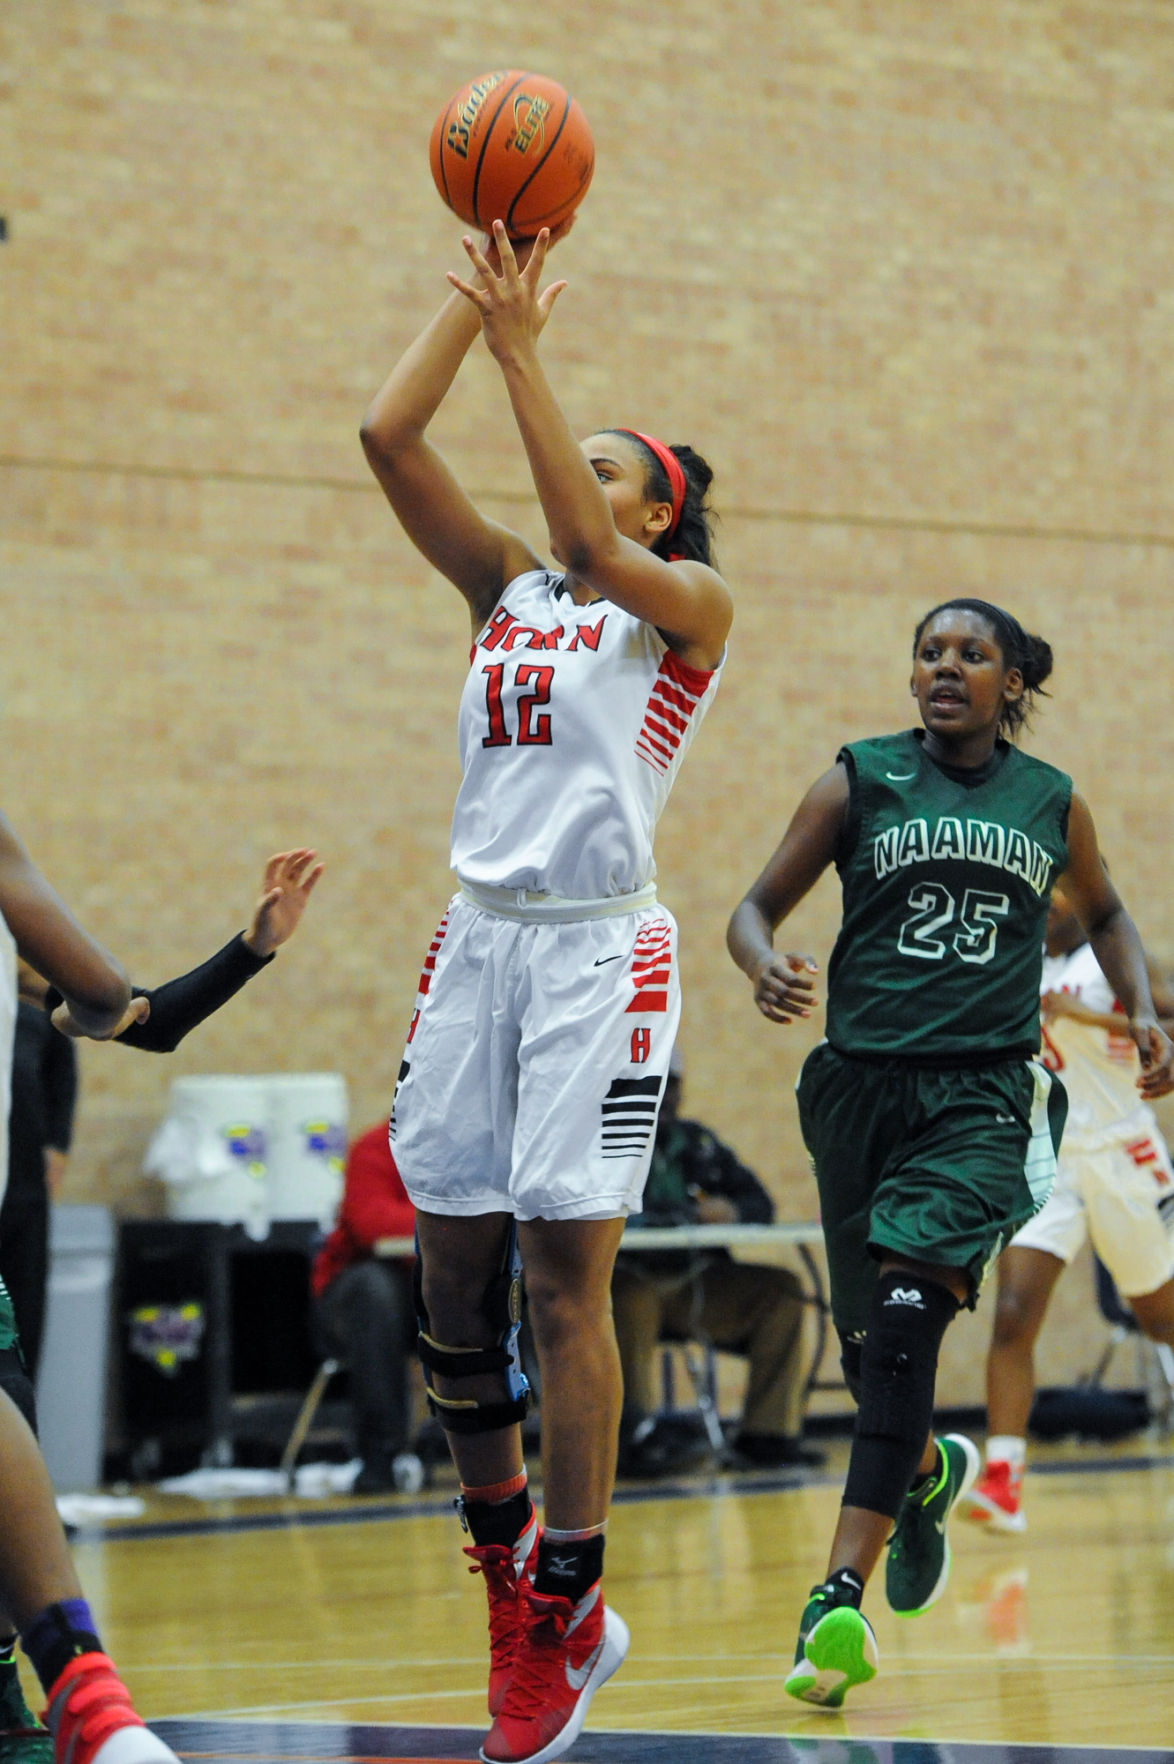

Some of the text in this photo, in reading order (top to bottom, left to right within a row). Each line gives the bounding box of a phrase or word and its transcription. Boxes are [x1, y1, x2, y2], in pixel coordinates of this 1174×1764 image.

[513, 95, 549, 155] ELITE
[481, 662, 555, 749] 12
[874, 817, 1054, 898] NAAMAN
[897, 881, 1010, 965] 25
[630, 1027, 651, 1063] H
